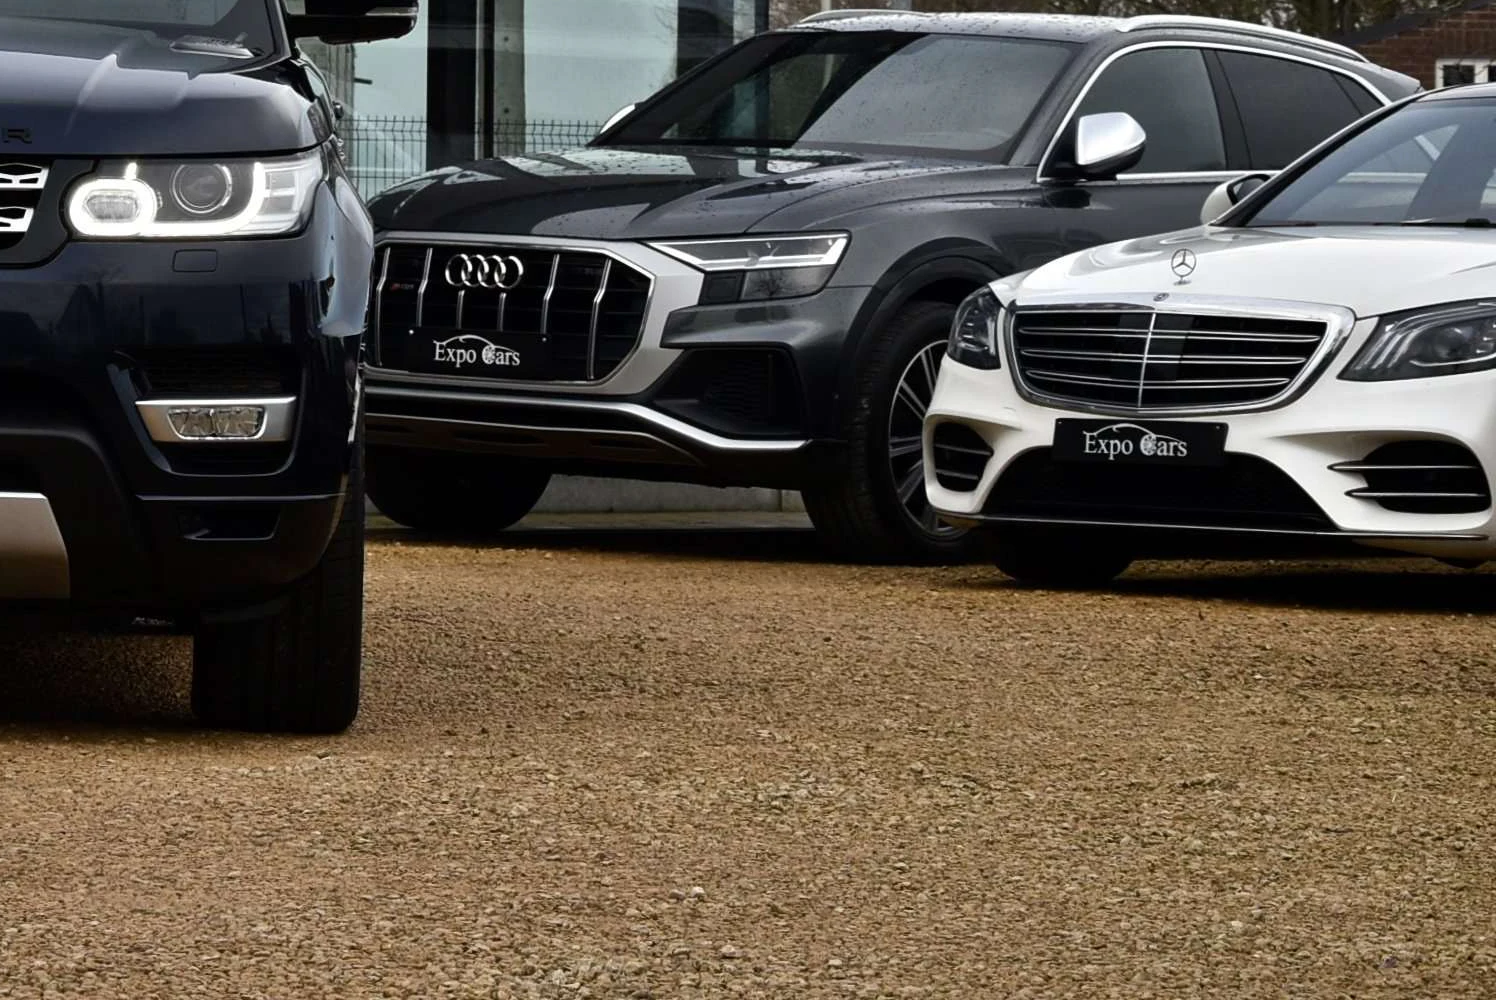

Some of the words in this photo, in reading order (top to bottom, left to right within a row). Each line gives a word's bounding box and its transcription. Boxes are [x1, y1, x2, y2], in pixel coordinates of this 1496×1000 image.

[434, 341, 477, 368] Expo
[482, 344, 521, 366] Cars
[1084, 433, 1134, 460] Expo
[1140, 435, 1187, 457] Cars
